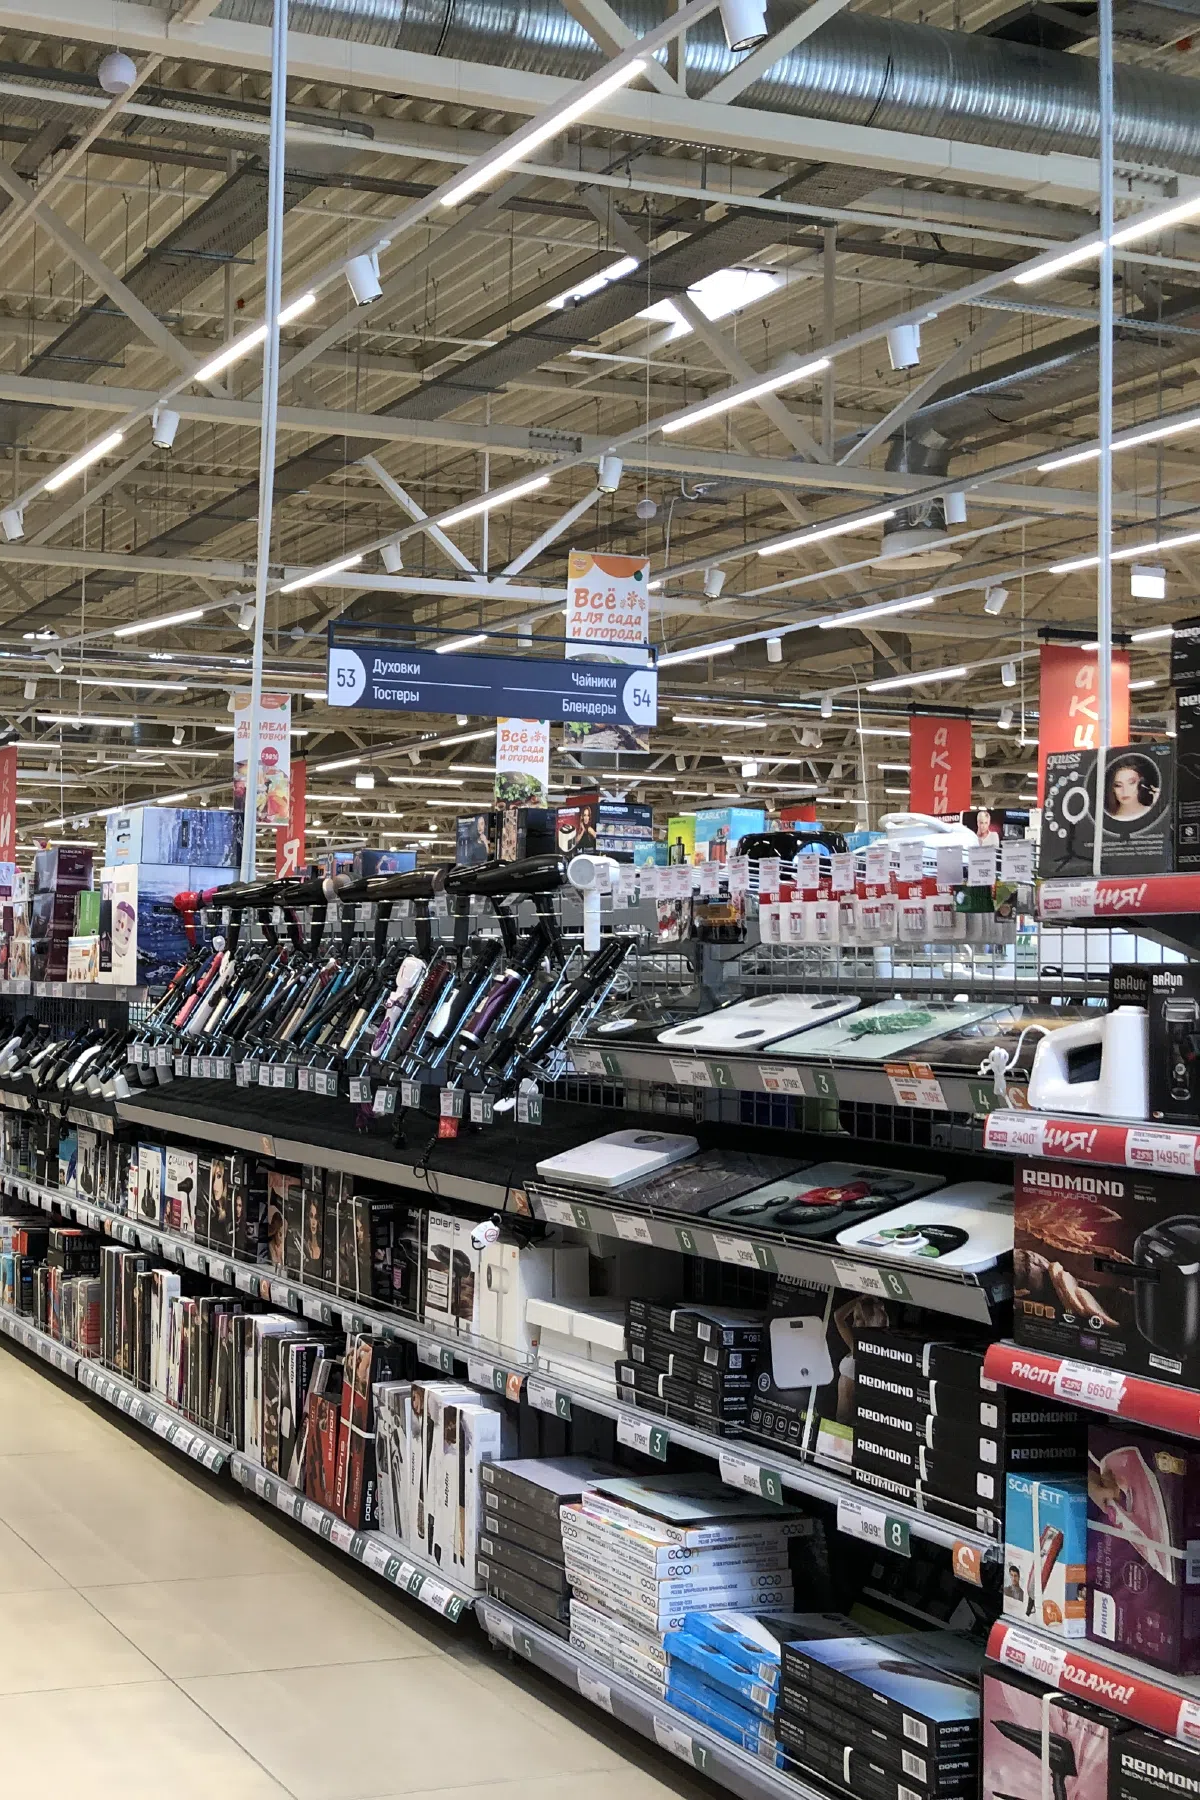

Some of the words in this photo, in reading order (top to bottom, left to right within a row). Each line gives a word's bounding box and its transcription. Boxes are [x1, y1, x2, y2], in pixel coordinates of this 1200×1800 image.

[574, 588, 617, 609] Всё
[571, 611, 604, 623] для
[607, 612, 642, 626] сада
[572, 628, 581, 637] и
[585, 627, 642, 641] огорода
[372, 658, 421, 677] Духовки
[336, 669, 356, 689] 53
[572, 672, 617, 688] Чайники
[372, 686, 420, 704] Тостеры
[633, 688, 651, 707] 54
[562, 699, 617, 716] Блендеры
[238, 721, 287, 731] ДАЕМ
[237, 732, 286, 741] ЗАТОВКИ
[501, 729, 528, 743] Всё
[499, 744, 520, 752] для
[522, 745, 544, 754] сада
[508, 754, 544, 763] огорода
[1047, 753, 1081, 770] gauss
[1153, 972, 1183, 986] BRAUN
[607, 1057, 615, 1072] 1
[327, 1078, 335, 1091] 20
[716, 1069, 727, 1085] 2
[818, 1074, 829, 1093] 3
[362, 1086, 368, 1099] 9
[387, 1094, 393, 1108] 9
[411, 1089, 419, 1104] 10
[978, 1090, 990, 1110] 4
[455, 1100, 462, 1114] 11
[483, 1103, 491, 1118] 13
[529, 1101, 540, 1118] 14
[1012, 1131, 1035, 1145] 2400
[1156, 1149, 1186, 1165] 14950
[1023, 1169, 1124, 1198] REDMOND
[430, 1216, 460, 1231] polars
[578, 1211, 587, 1226] 5
[681, 1231, 691, 1249] 6
[756, 1249, 768, 1266] 7
[887, 1274, 903, 1295] 8
[443, 1352, 449, 1369] 5
[857, 1341, 913, 1364] REDMOND
[496, 1372, 502, 1389] 6
[858, 1374, 914, 1398] REDMOND
[1087, 1382, 1112, 1399] 6650
[560, 1398, 567, 1415] 2
[857, 1406, 913, 1433] REDMOND
[1012, 1412, 1077, 1423] REDMOND
[654, 1433, 661, 1453] 3
[857, 1438, 911, 1465] REDMOND
[1011, 1448, 1076, 1460] REDMOND
[336, 1440, 345, 1507] polaris
[766, 1477, 775, 1496] 6
[363, 1480, 373, 1522] polaris
[321, 1517, 331, 1533] 10
[861, 1520, 879, 1536] 1899
[892, 1522, 902, 1546] 8
[354, 1538, 362, 1553] 11
[387, 1560, 397, 1577] 12
[410, 1571, 420, 1589] 13
[449, 1597, 461, 1615] 14
[1101, 1597, 1109, 1635] PHILIPS
[524, 1638, 530, 1657] 5
[1032, 1656, 1055, 1676] 1000
[940, 1726, 969, 1734] polaris
[699, 1748, 706, 1767] 7
[1121, 1753, 1200, 1792] REDMON
